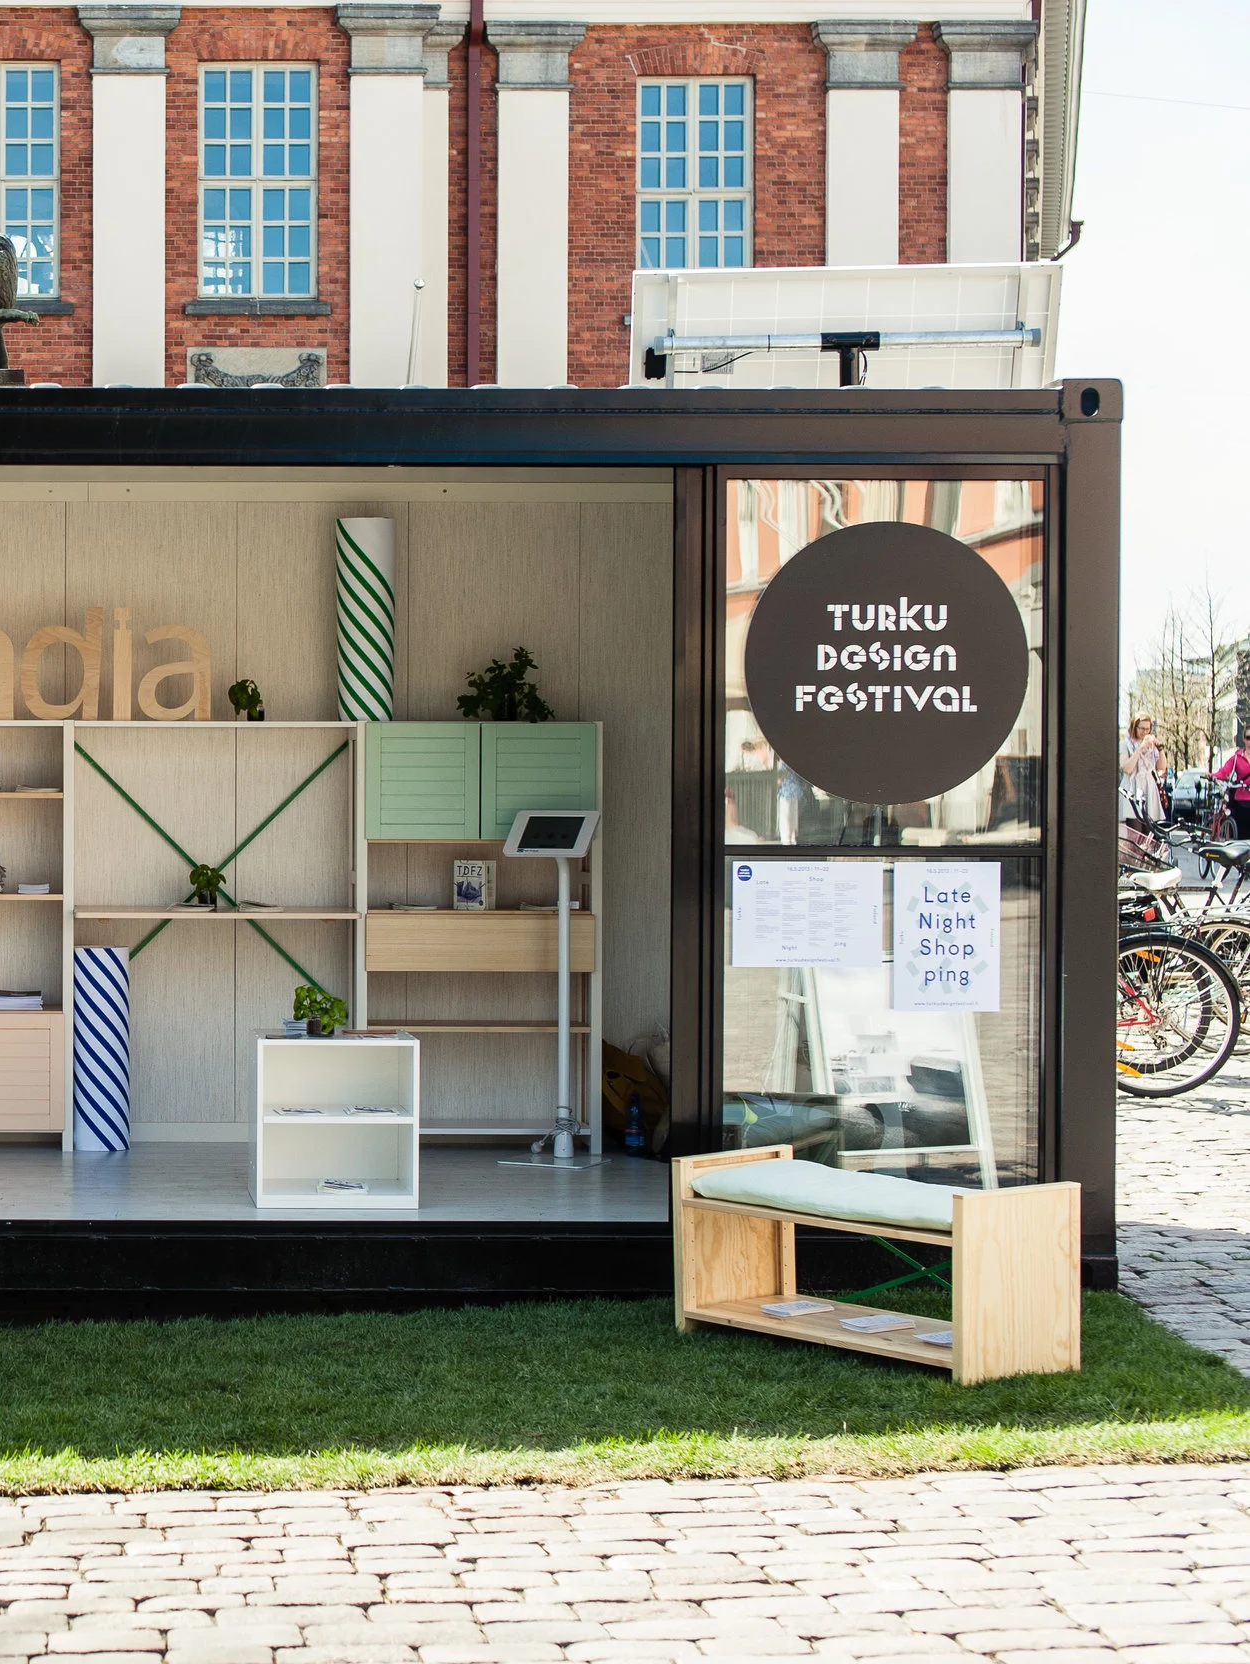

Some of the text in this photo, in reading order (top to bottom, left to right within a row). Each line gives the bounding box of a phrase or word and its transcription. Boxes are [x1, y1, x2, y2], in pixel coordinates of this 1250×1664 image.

[826, 596, 949, 632] TURKU
[816, 640, 957, 671] DESIGN
[795, 682, 978, 713] FESTIVAL
[456, 865, 483, 876] TDFZ
[924, 886, 971, 903] Late
[919, 912, 976, 934] Night
[920, 938, 975, 960] Shop
[924, 966, 970, 986] ping
